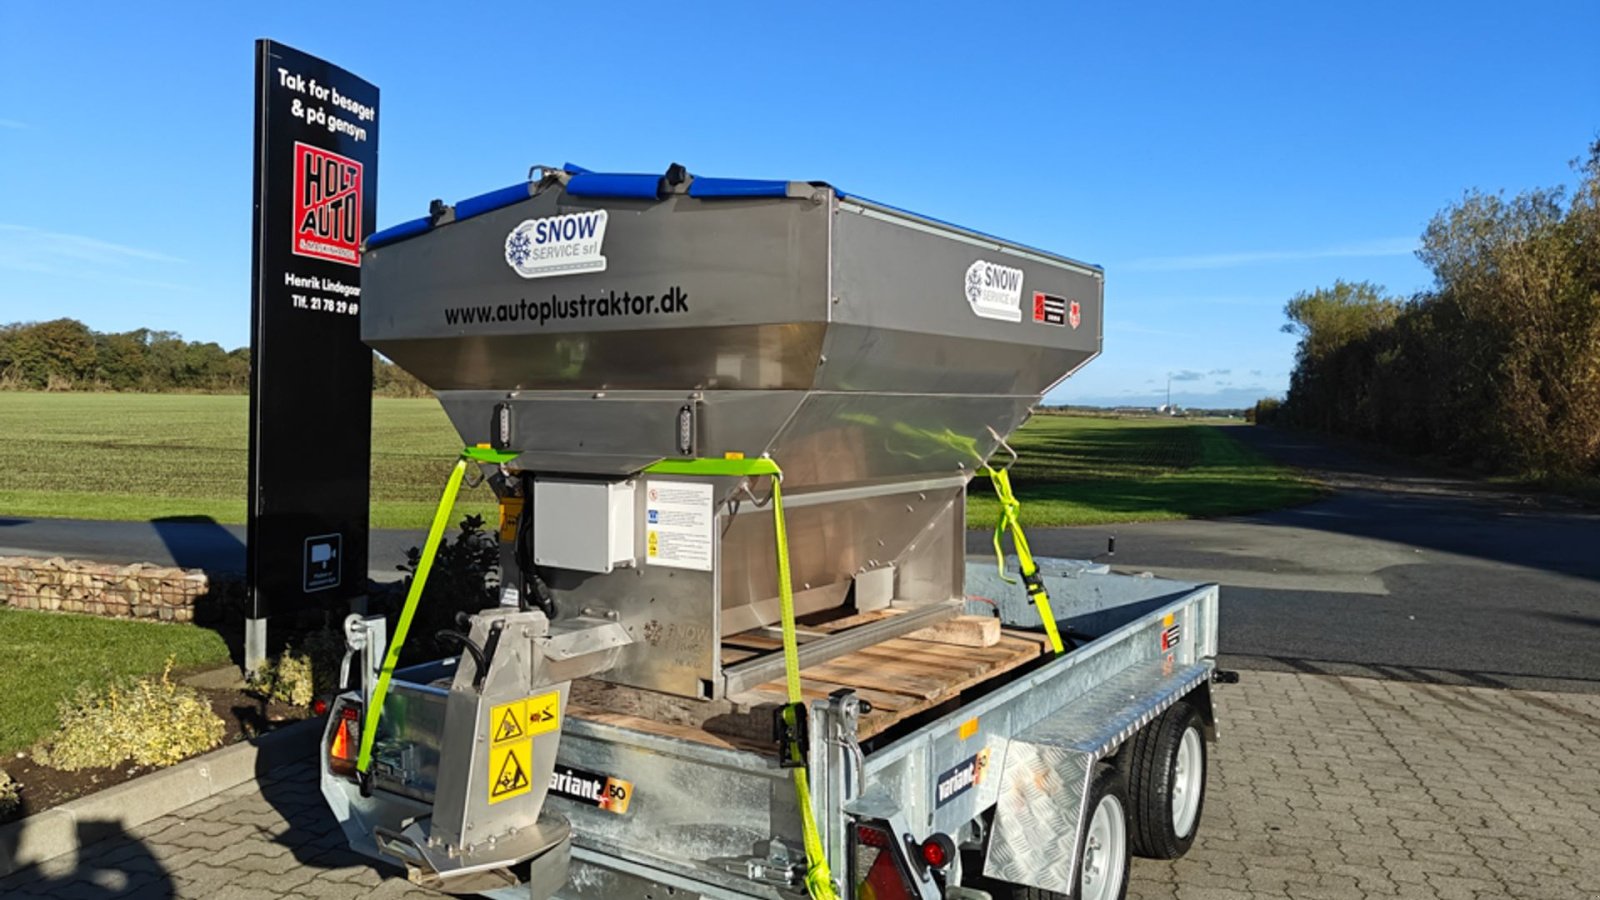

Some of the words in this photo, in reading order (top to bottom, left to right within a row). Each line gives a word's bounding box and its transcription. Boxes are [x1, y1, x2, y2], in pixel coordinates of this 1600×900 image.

[278, 67, 306, 93] Tak
[309, 79, 330, 101] for
[331, 88, 375, 121] besøget
[291, 99, 304, 118] &
[306, 107, 326, 124] på
[327, 115, 367, 141] gensyn
[304, 151, 357, 207] HOLT
[301, 191, 356, 243] AUTO
[535, 215, 599, 244] SNOW
[532, 243, 580, 261] SERVICE
[582, 241, 597, 255] srl
[284, 272, 320, 290] Henrik
[985, 266, 1019, 291] SNOW
[291, 294, 308, 309] Tlf.
[310, 297, 321, 310] 21
[323, 298, 335, 312] 78
[335, 300, 348, 314] 29
[445, 286, 689, 326] www.autoplustraktor.dk
[549, 770, 602, 800] ariant
[609, 786, 627, 801] 50
[938, 761, 974, 802] variant
